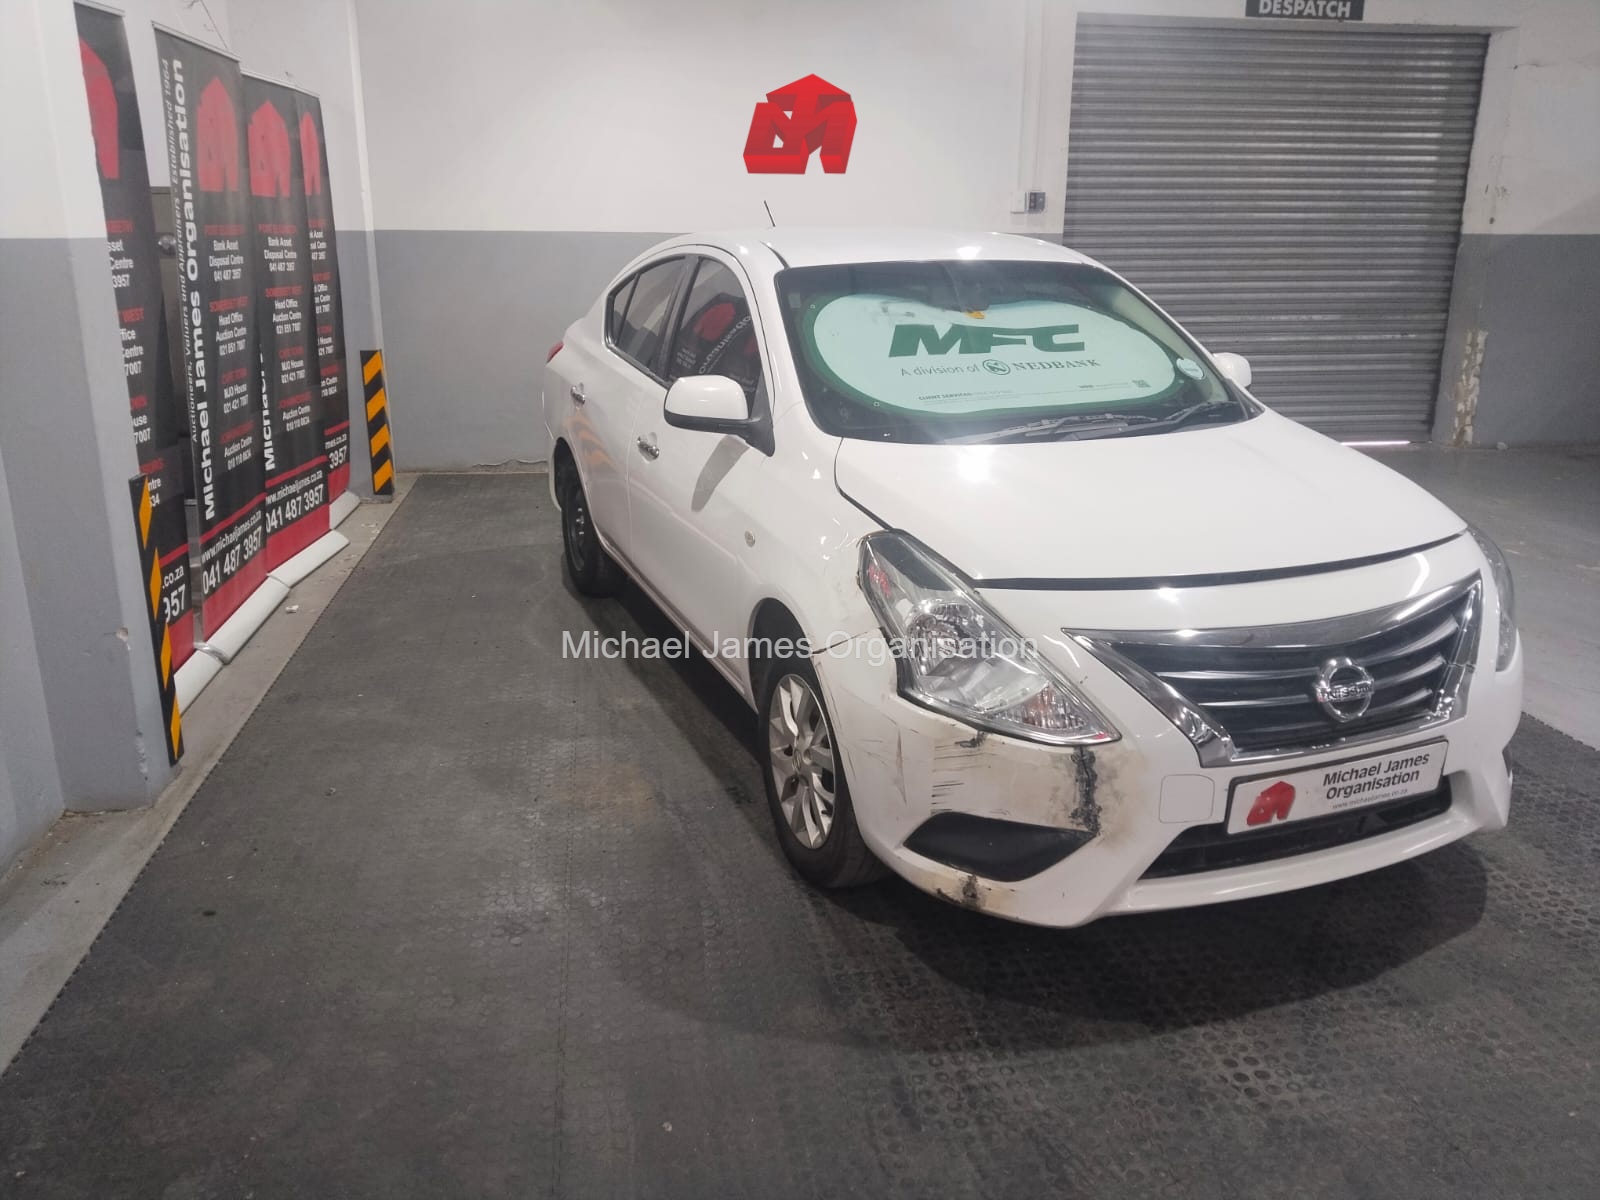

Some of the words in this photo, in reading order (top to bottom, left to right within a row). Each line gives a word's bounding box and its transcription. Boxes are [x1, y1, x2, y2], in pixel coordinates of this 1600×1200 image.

[1258, 0, 1351, 18] DESPATCH
[173, 59, 198, 281] Organisation
[190, 290, 207, 393] James
[889, 323, 1085, 358] MFC
[124, 360, 142, 376] 7007
[901, 367, 911, 377] A
[913, 364, 965, 376] division
[967, 363, 980, 373] of
[1012, 359, 1101, 372] NEDBANK
[197, 402, 215, 520] Michael
[329, 446, 347, 469] 3957
[285, 495, 302, 520] 487
[304, 484, 324, 511] 3957
[203, 560, 220, 594] 041
[224, 544, 241, 575] 487
[243, 526, 262, 560] 3957
[1323, 762, 1382, 786] Michael
[1384, 753, 1430, 774] James
[1326, 770, 1420, 800] Organisation
